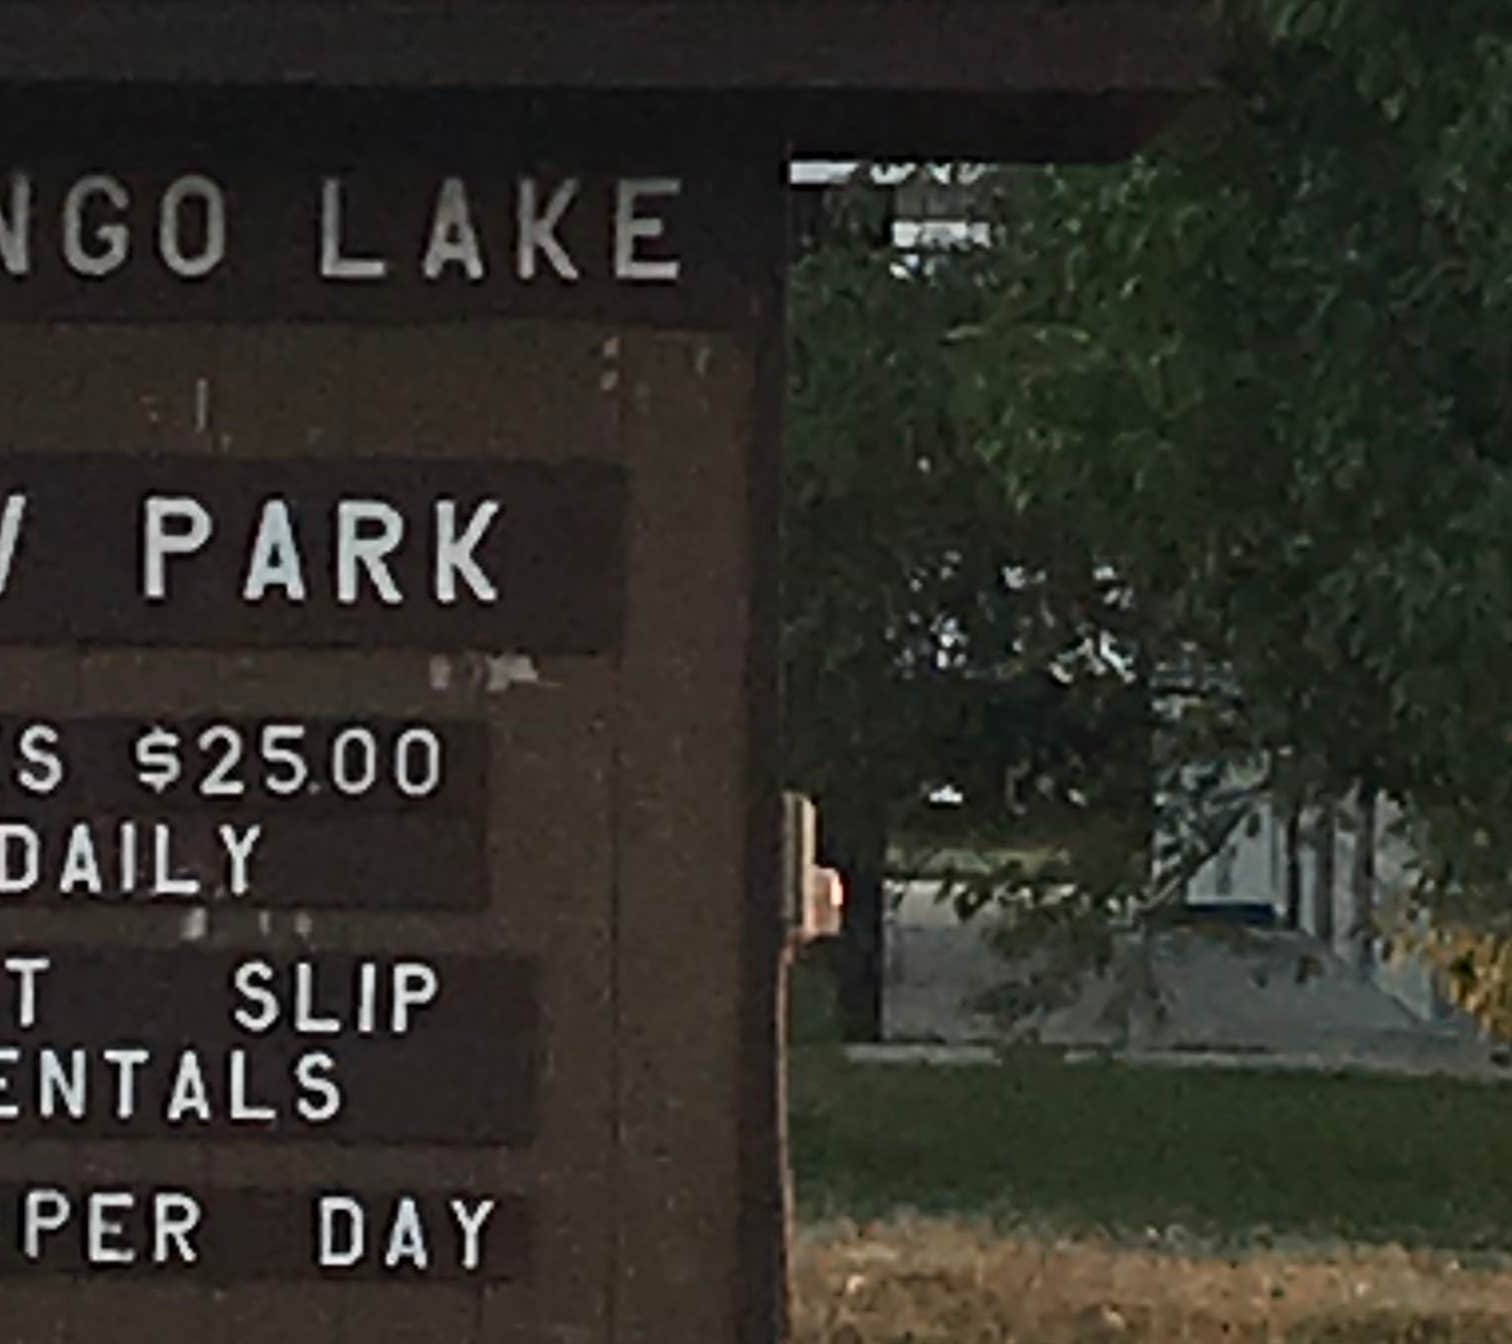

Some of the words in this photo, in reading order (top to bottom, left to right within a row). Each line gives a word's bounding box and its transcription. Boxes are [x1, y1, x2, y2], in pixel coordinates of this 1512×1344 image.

[317, 175, 684, 282] LAKE
[142, 495, 502, 605] PARK
[133, 723, 442, 797] $25.00
[233, 959, 440, 1035] SLIP
[23, 1187, 203, 1264] PER
[318, 1194, 497, 1271] DAY
